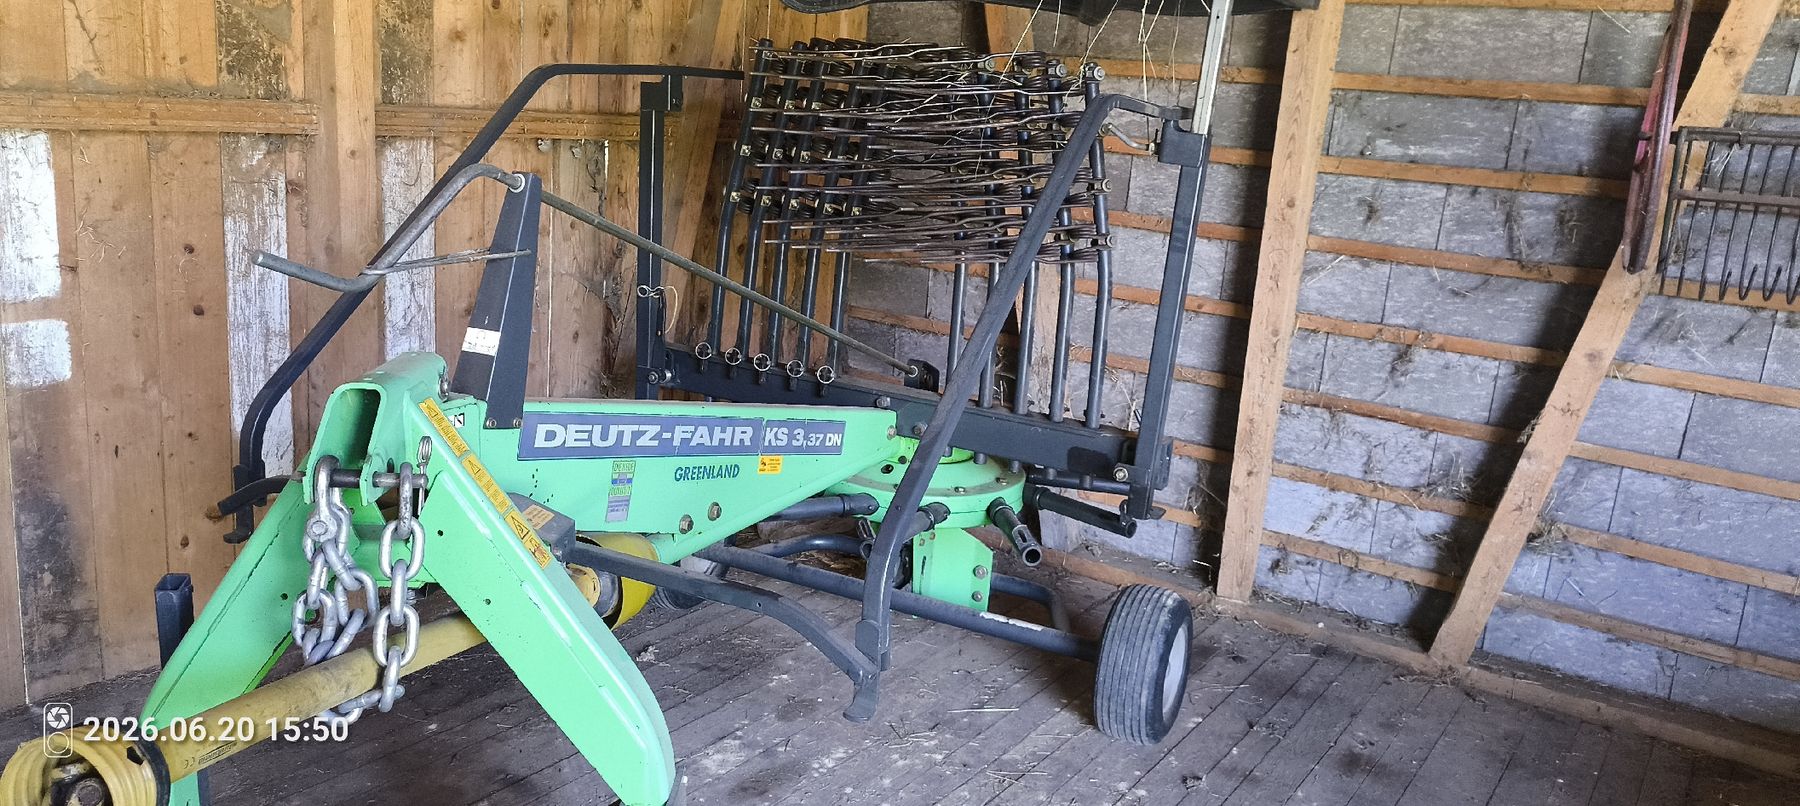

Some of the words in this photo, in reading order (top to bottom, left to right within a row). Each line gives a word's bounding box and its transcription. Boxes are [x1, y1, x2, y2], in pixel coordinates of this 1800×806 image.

[534, 423, 754, 448] DEUTZ-FAHR
[764, 427, 789, 447] KS
[791, 428, 824, 450] 3,37
[825, 433, 842, 447] DN
[674, 463, 740, 482] GREENLAND
